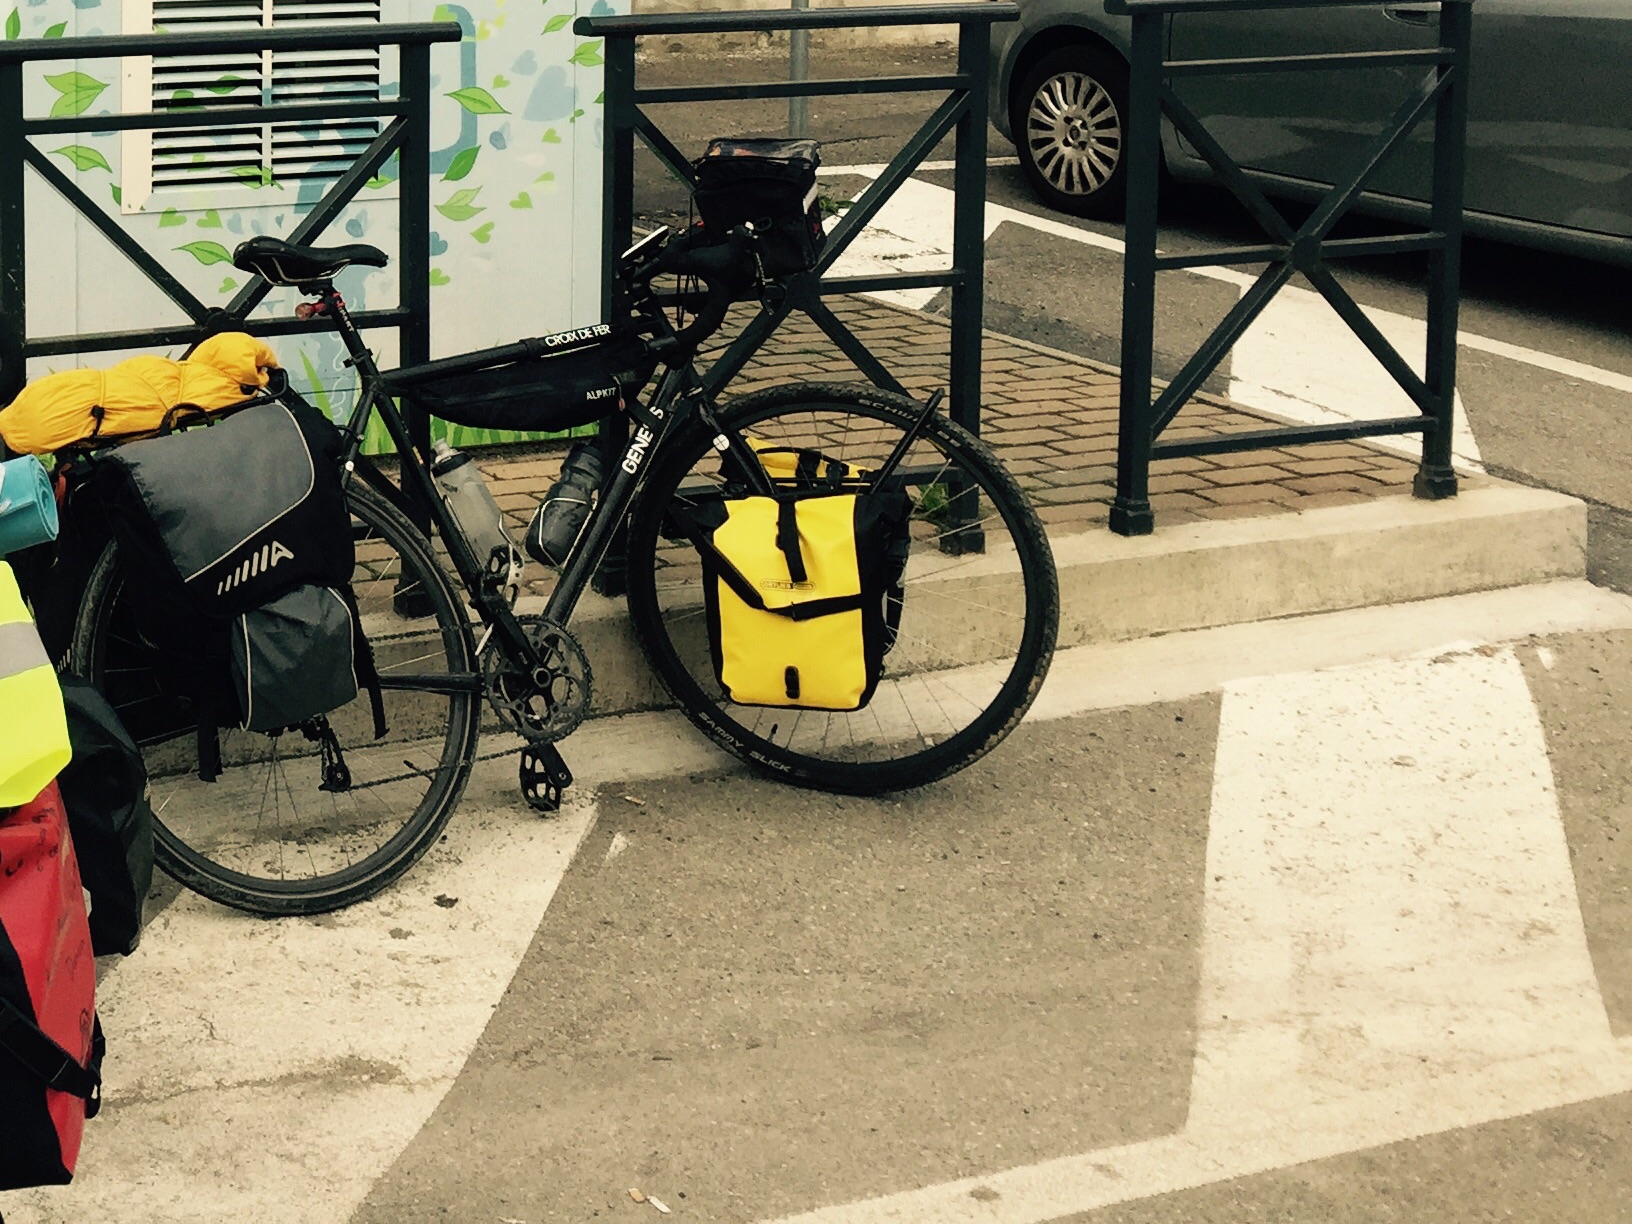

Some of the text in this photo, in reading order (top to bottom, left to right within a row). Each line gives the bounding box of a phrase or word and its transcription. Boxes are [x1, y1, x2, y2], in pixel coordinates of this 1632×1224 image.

[544, 324, 612, 347] CROIX DE FER
[698, 711, 793, 773] SAMMY SLICK
